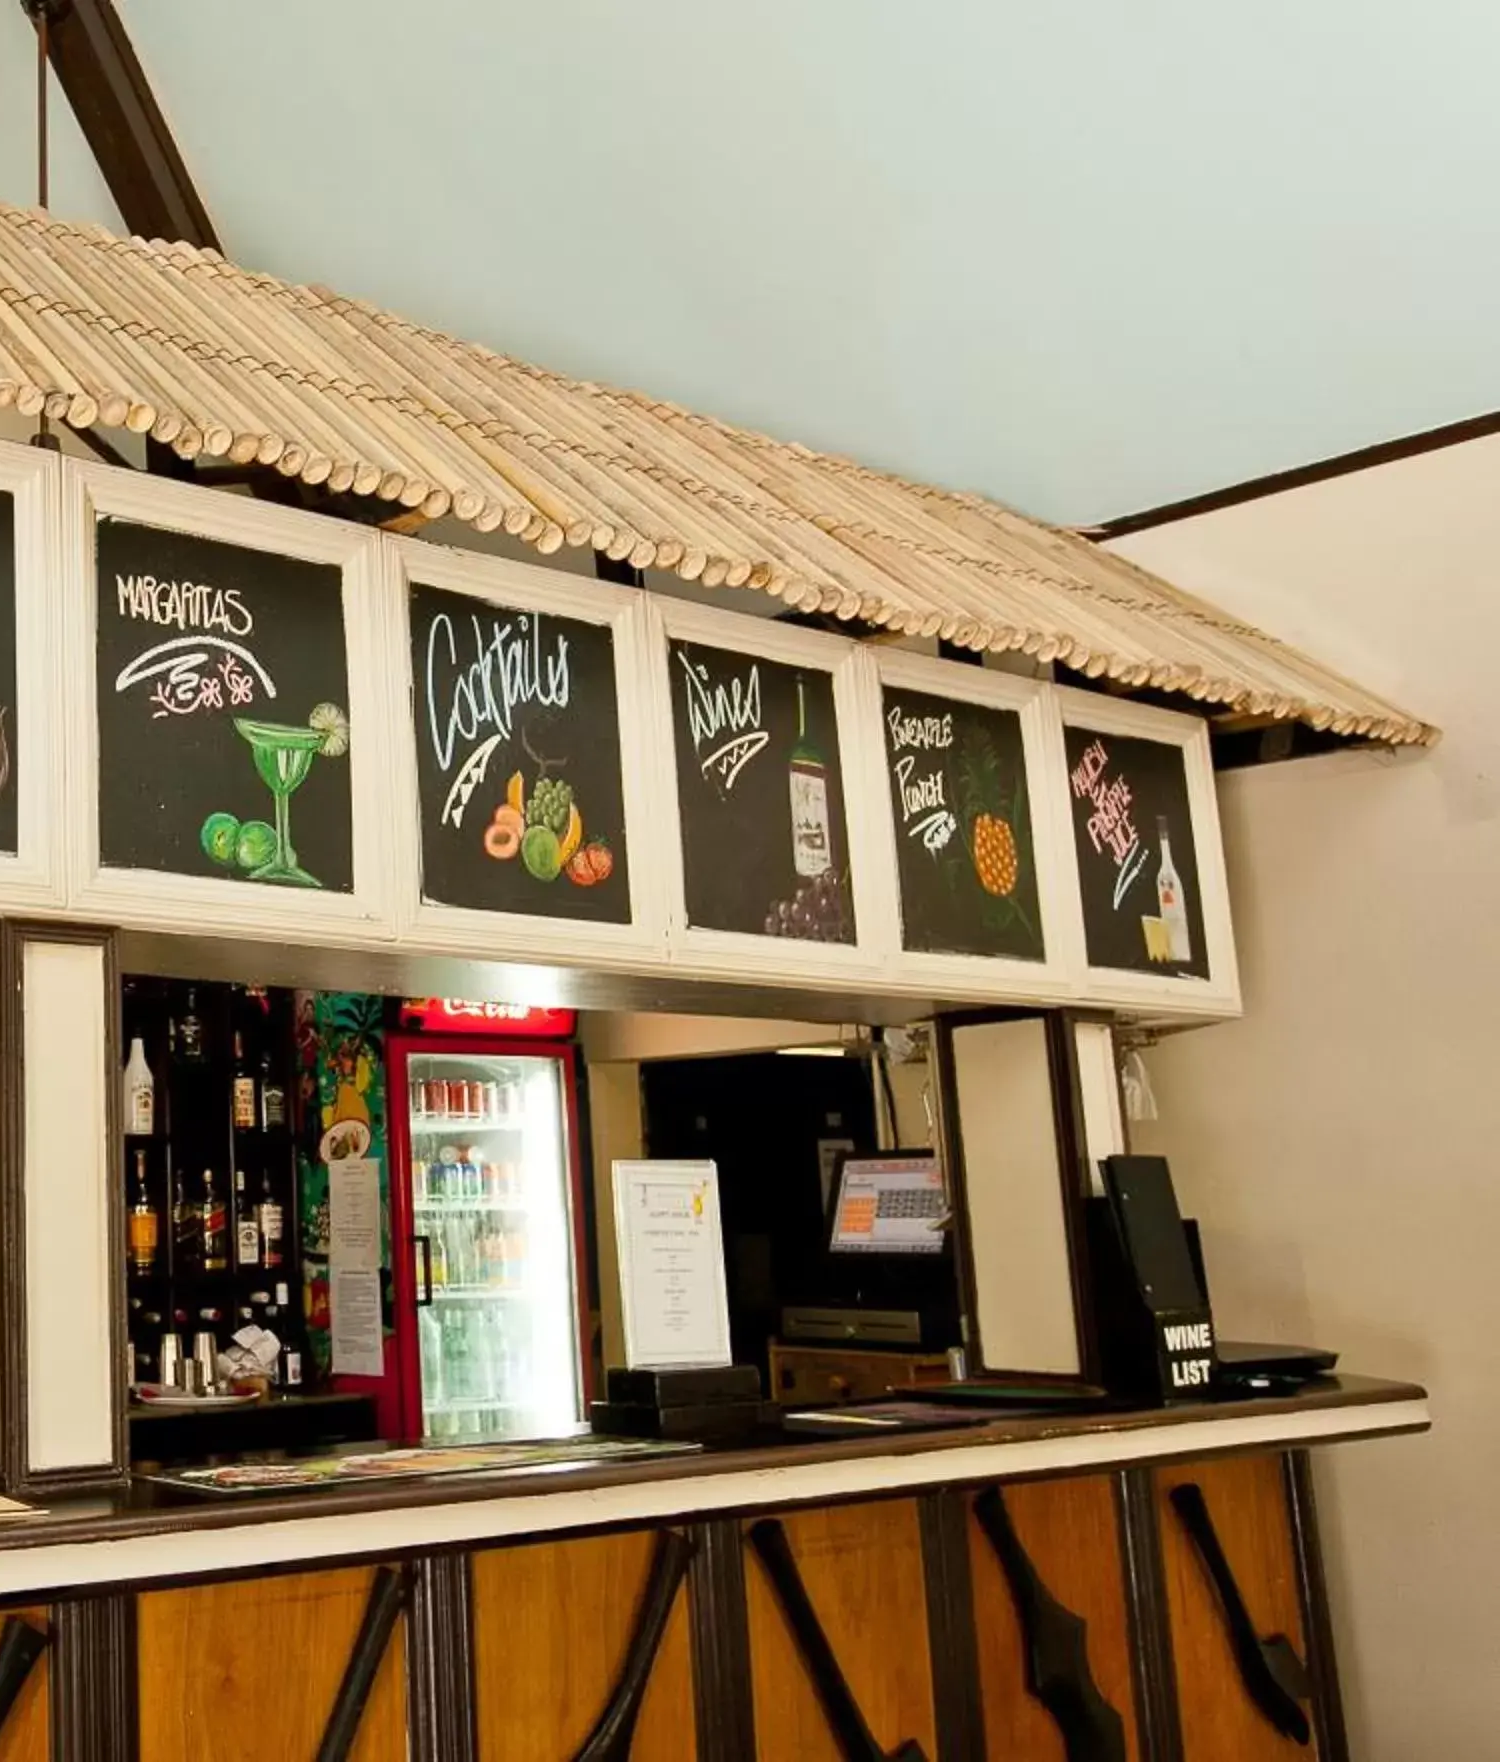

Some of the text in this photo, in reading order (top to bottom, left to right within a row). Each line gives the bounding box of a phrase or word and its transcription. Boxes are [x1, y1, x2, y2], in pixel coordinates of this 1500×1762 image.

[115, 574, 253, 636] MARGARITAS
[427, 609, 569, 770] Cocktails
[894, 755, 946, 822] PUNCH
[1163, 1323, 1212, 1351] WINE
[1171, 1360, 1211, 1387] LIST
